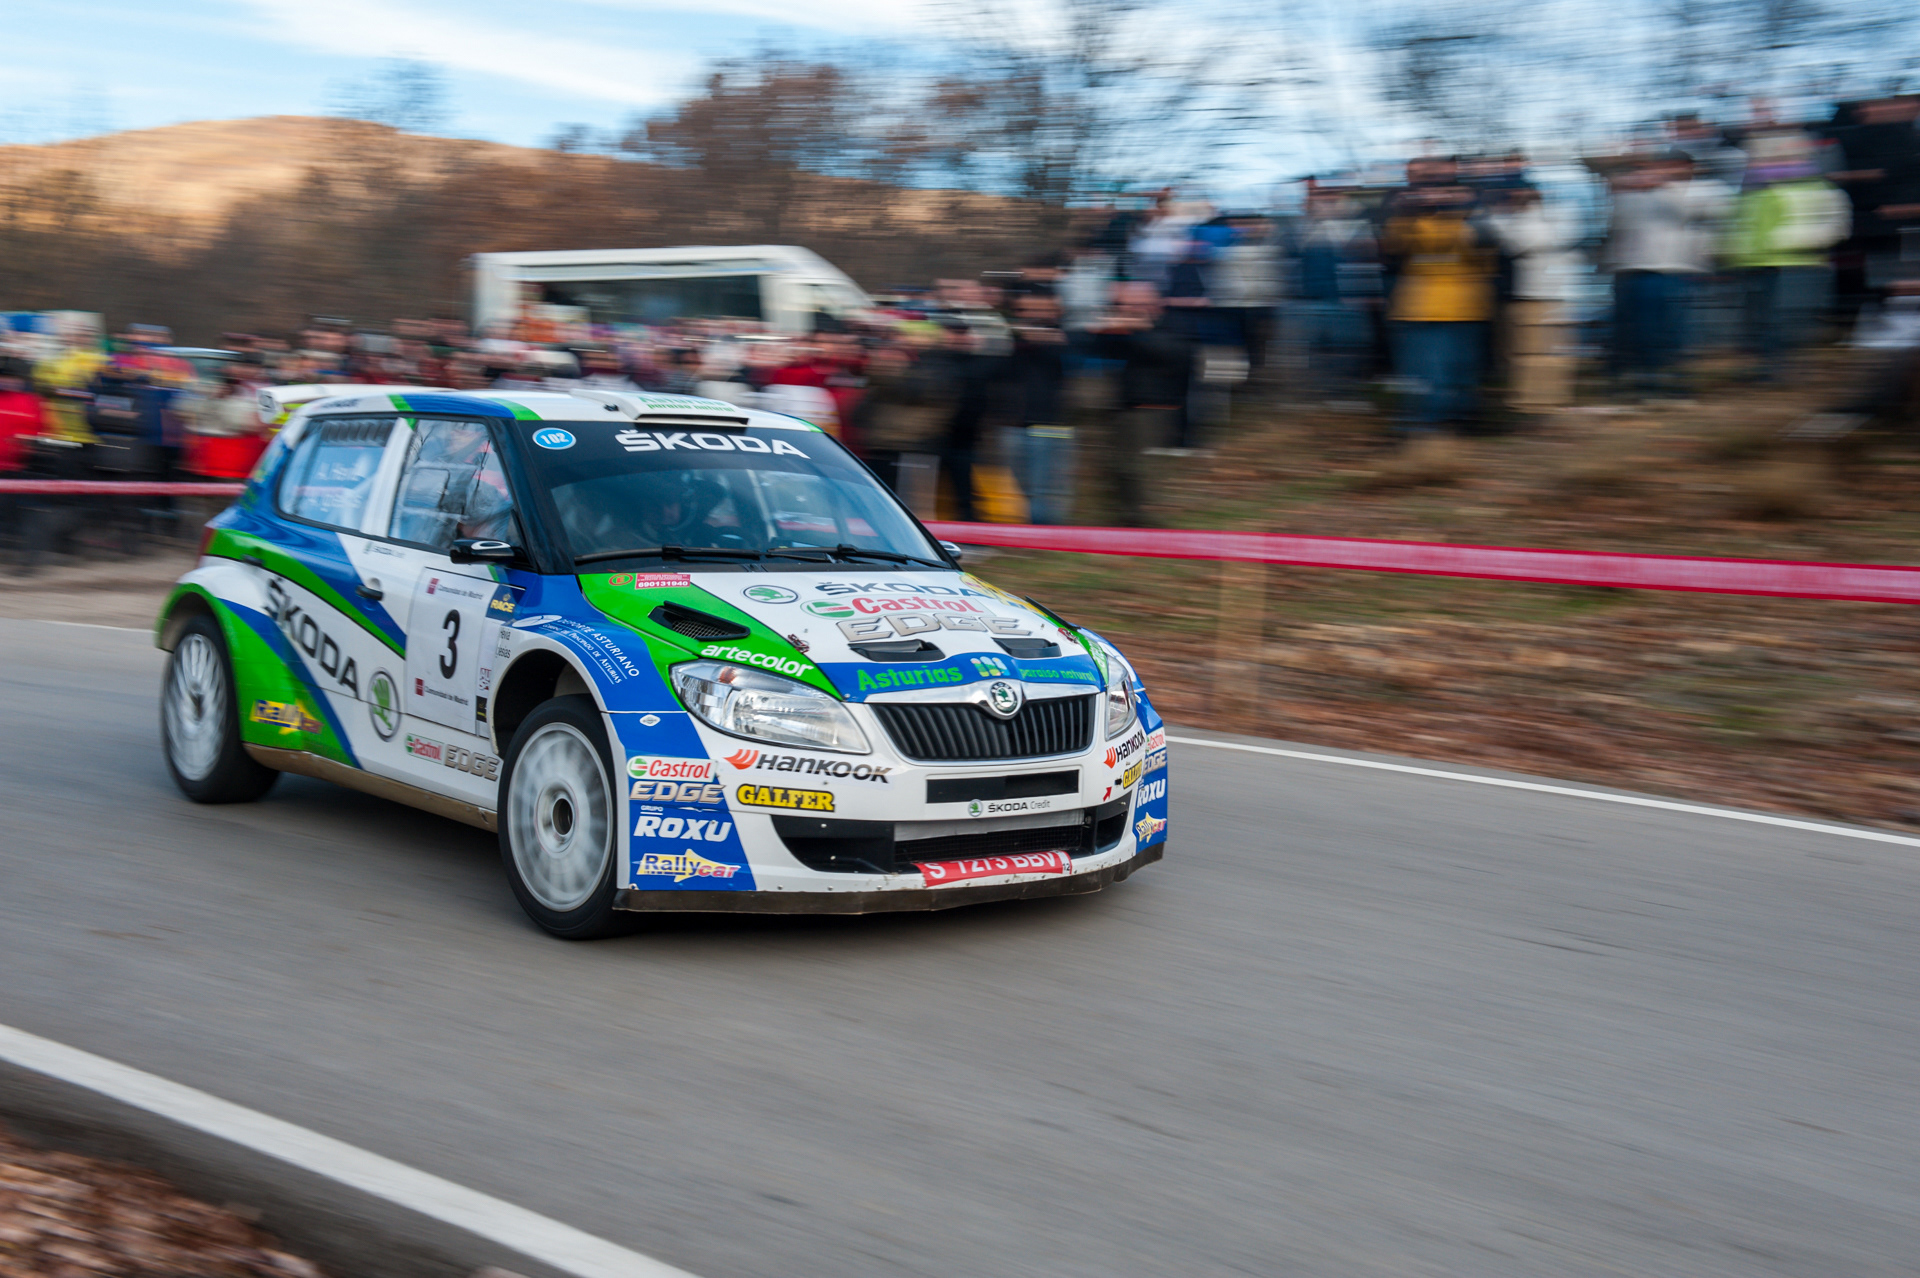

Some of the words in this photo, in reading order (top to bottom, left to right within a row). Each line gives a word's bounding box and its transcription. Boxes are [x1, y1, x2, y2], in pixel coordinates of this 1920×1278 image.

[540, 432, 570, 445] 102
[614, 429, 811, 460] ŠKODA
[814, 581, 998, 601] ŠKODA
[490, 599, 516, 613] RACE
[851, 597, 984, 614] Castrol
[263, 576, 360, 701] ŠKODA
[836, 612, 1033, 642] EDGE
[439, 609, 460, 679] 3
[591, 632, 640, 677] ASTURIANO
[700, 644, 814, 677] artecolor
[1018, 667, 1060, 679] paraiso
[1060, 669, 1097, 681] natural
[857, 664, 963, 692] Asturias
[444, 744, 500, 783] EDGE
[649, 759, 712, 779] Castrol
[630, 781, 727, 804] EDGE
[737, 784, 836, 812] GALFER
[1136, 779, 1167, 808] ROXU
[987, 801, 1029, 813] ŠKODA
[1030, 801, 1051, 810] Credit
[633, 815, 732, 842] ROXU
[645, 855, 741, 879] Rallycar
[924, 862, 946, 879] S
